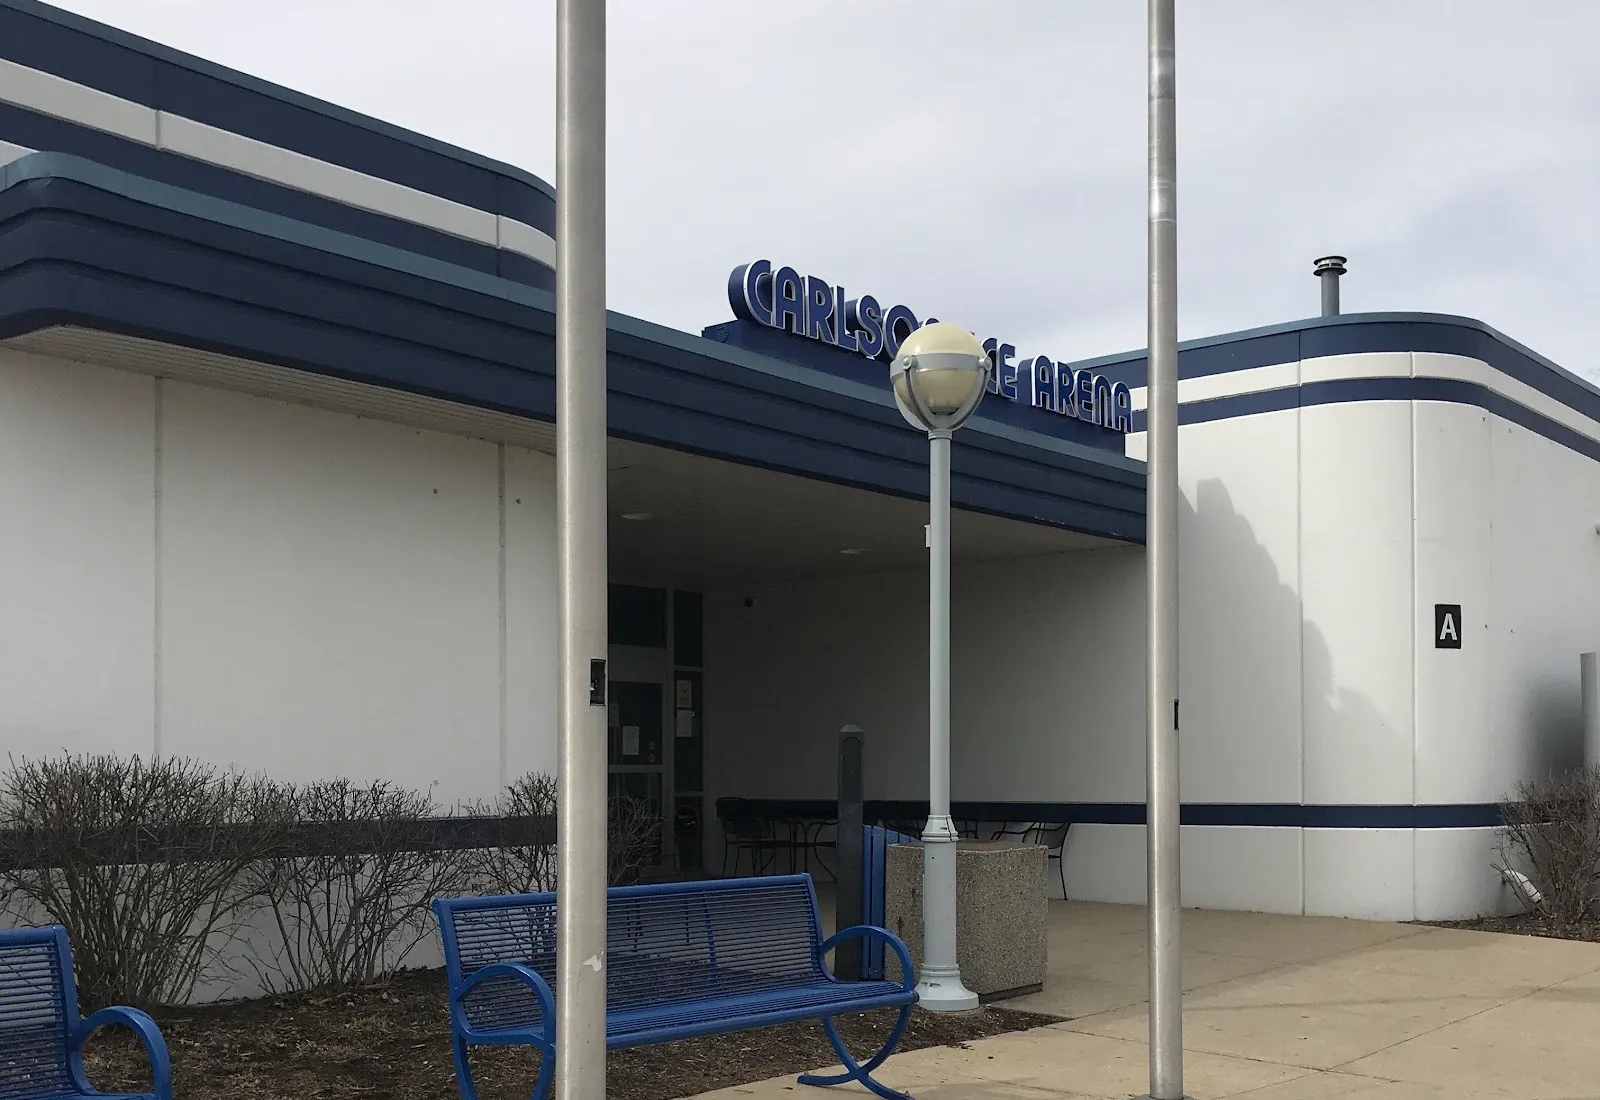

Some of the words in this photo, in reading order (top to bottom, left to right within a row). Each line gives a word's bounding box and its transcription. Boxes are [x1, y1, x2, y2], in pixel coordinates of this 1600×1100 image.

[730, 258, 940, 360] CARLSO
[974, 334, 1018, 400] CE
[1029, 355, 1134, 433] ARENA
[1440, 613, 1458, 640] A
